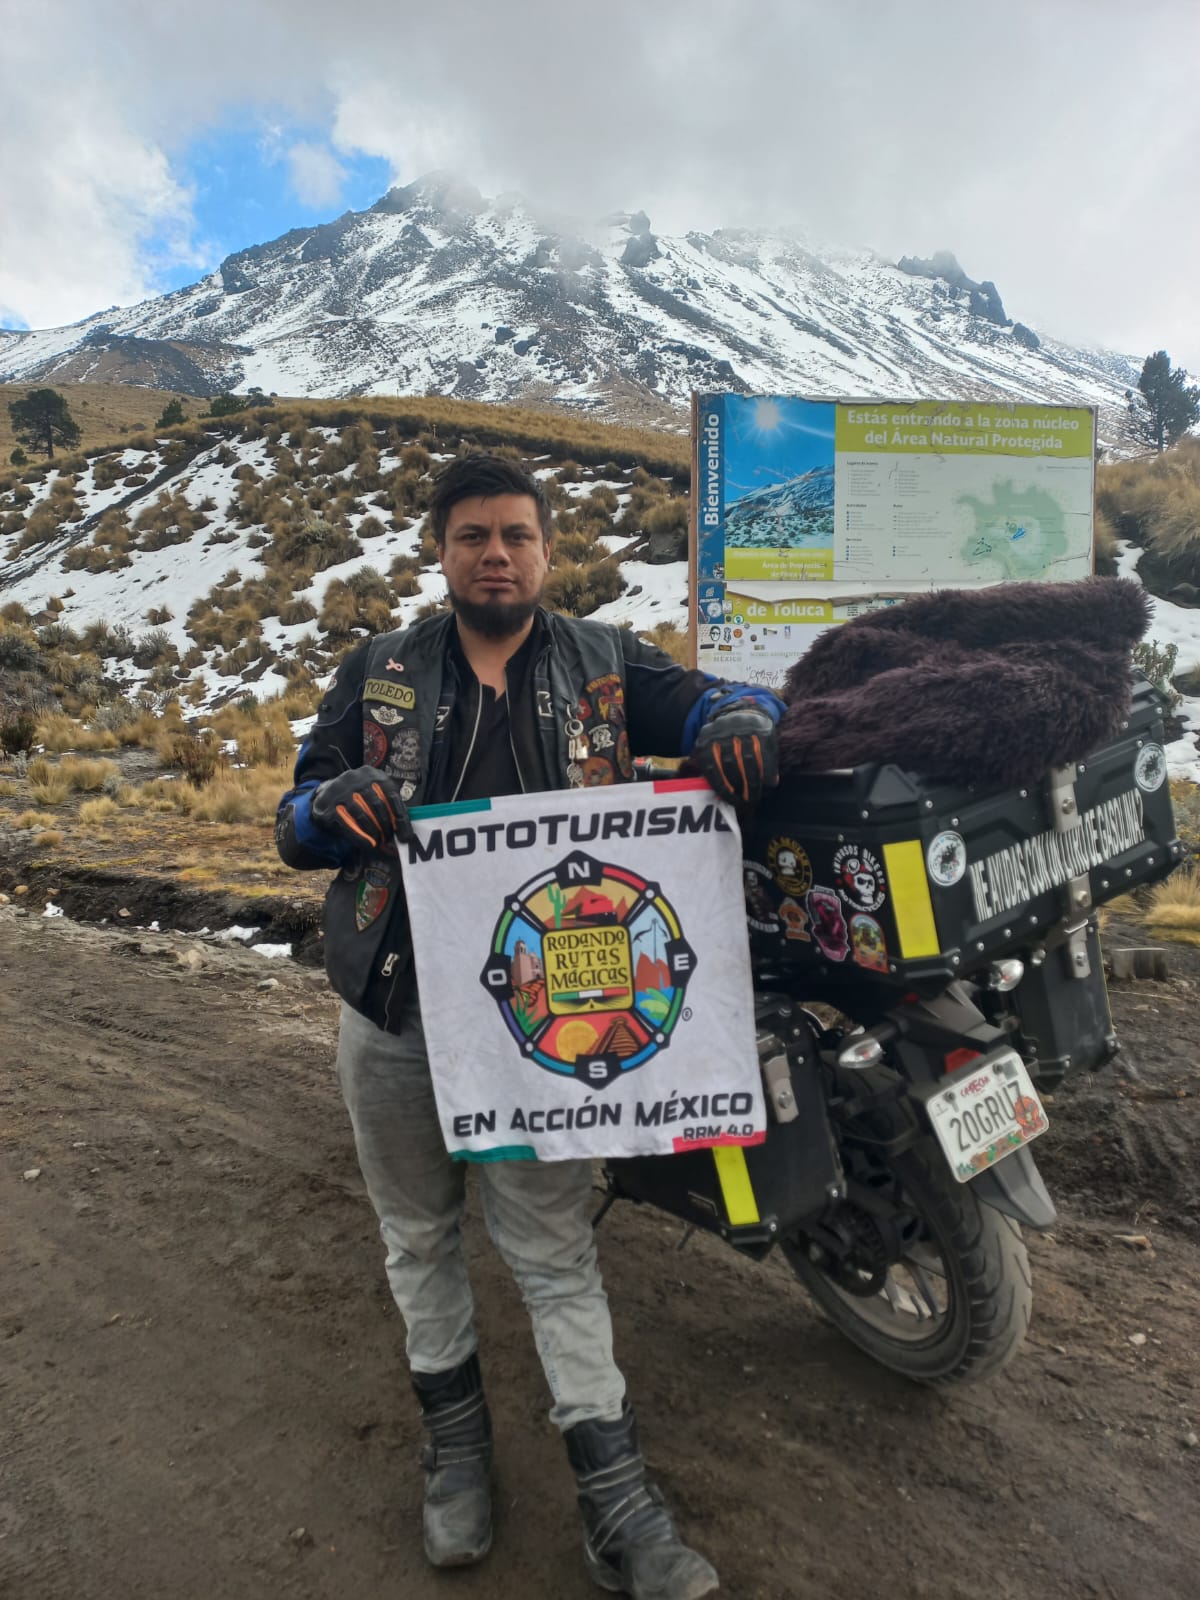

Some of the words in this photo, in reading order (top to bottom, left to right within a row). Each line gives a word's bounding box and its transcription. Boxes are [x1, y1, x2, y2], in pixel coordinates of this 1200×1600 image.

[847, 409, 888, 425] Estás
[892, 411, 960, 426] entrando
[965, 416, 974, 427] a
[978, 412, 993, 428] la
[995, 416, 1029, 429] zona
[1032, 413, 1080, 430] núcleo
[865, 430, 887, 444] del
[891, 427, 928, 445] Área
[932, 432, 988, 447] Natural
[992, 432, 1063, 450] Protegida
[703, 413, 719, 525] Bienvenido
[747, 602, 767, 616] de
[773, 603, 825, 616] Toluca
[366, 681, 414, 703] TOLEDO
[969, 859, 994, 923] ME
[986, 841, 1031, 916] AYUDAS
[1022, 831, 1053, 897] CON
[1042, 827, 1067, 887] UN
[1083, 808, 1104, 867] DE
[1096, 788, 1145, 861] GASOLINA?
[567, 861, 591, 879] N
[674, 953, 690, 971] E
[487, 969, 507, 985] O
[588, 1061, 608, 1079] S
[453, 1109, 496, 1138] EN
[510, 1096, 622, 1133] ACCIÓN
[635, 1090, 753, 1127] MÉXICO
[949, 1080, 1027, 1152] 20GRU7
[683, 1124, 721, 1142] RRM
[728, 1123, 755, 1137] 4.0
